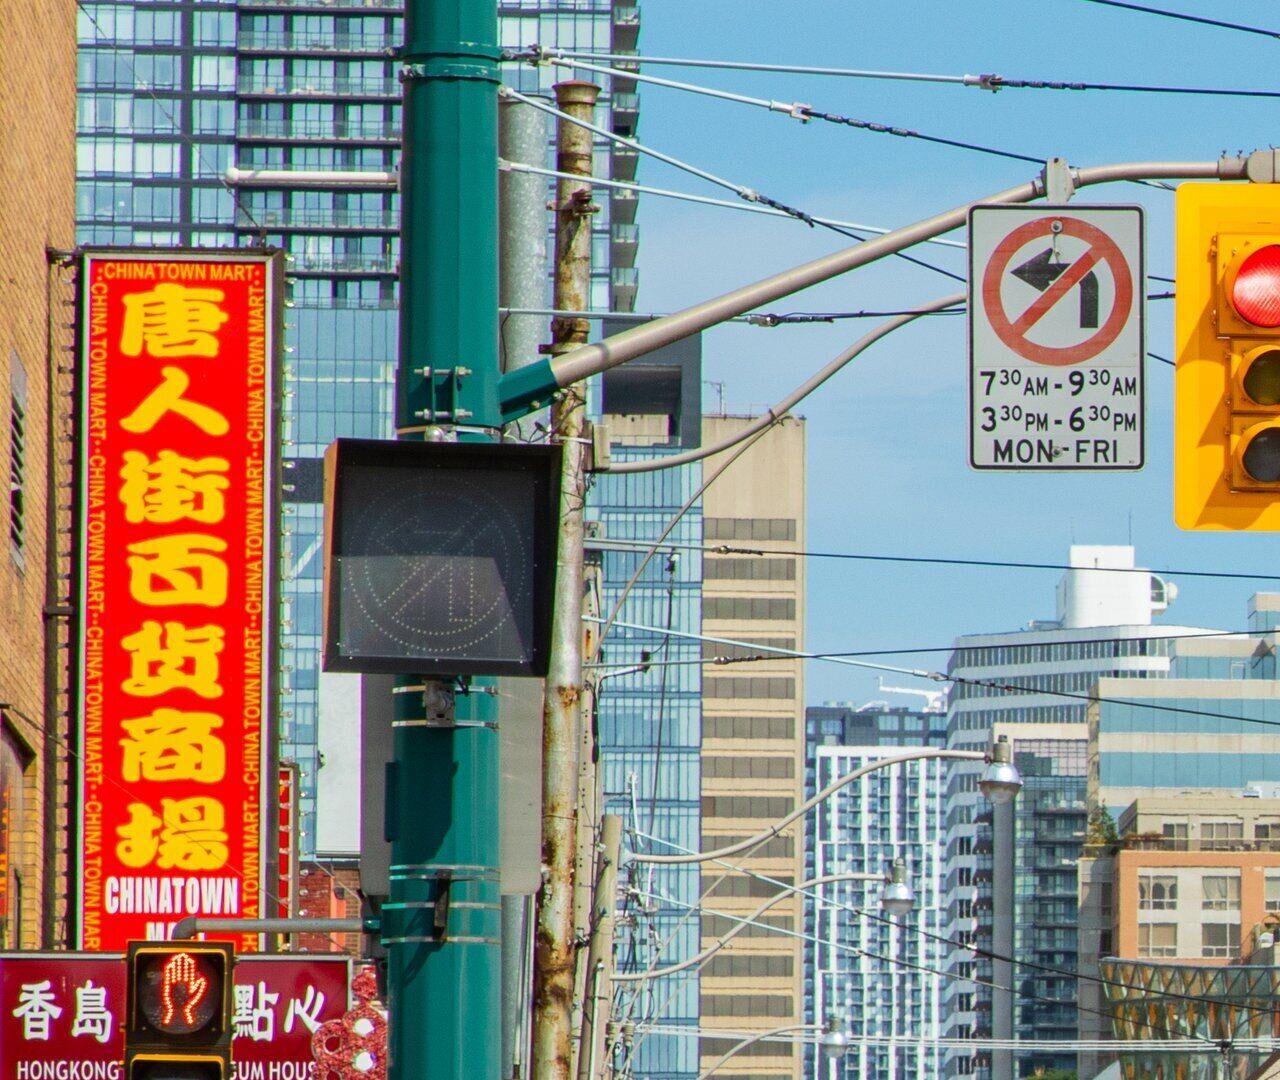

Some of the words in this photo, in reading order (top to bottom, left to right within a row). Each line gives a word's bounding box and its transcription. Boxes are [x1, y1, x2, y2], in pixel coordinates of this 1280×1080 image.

[104, 263, 155, 279] CHINA
[156, 264, 206, 279] TOWN
[210, 265, 255, 281] MART
[105, 876, 239, 914] CHINATOWN
[84, 911, 101, 950] MAR
[12, 980, 113, 1043] 香島
[17, 1061, 119, 1080] HONGKONG
